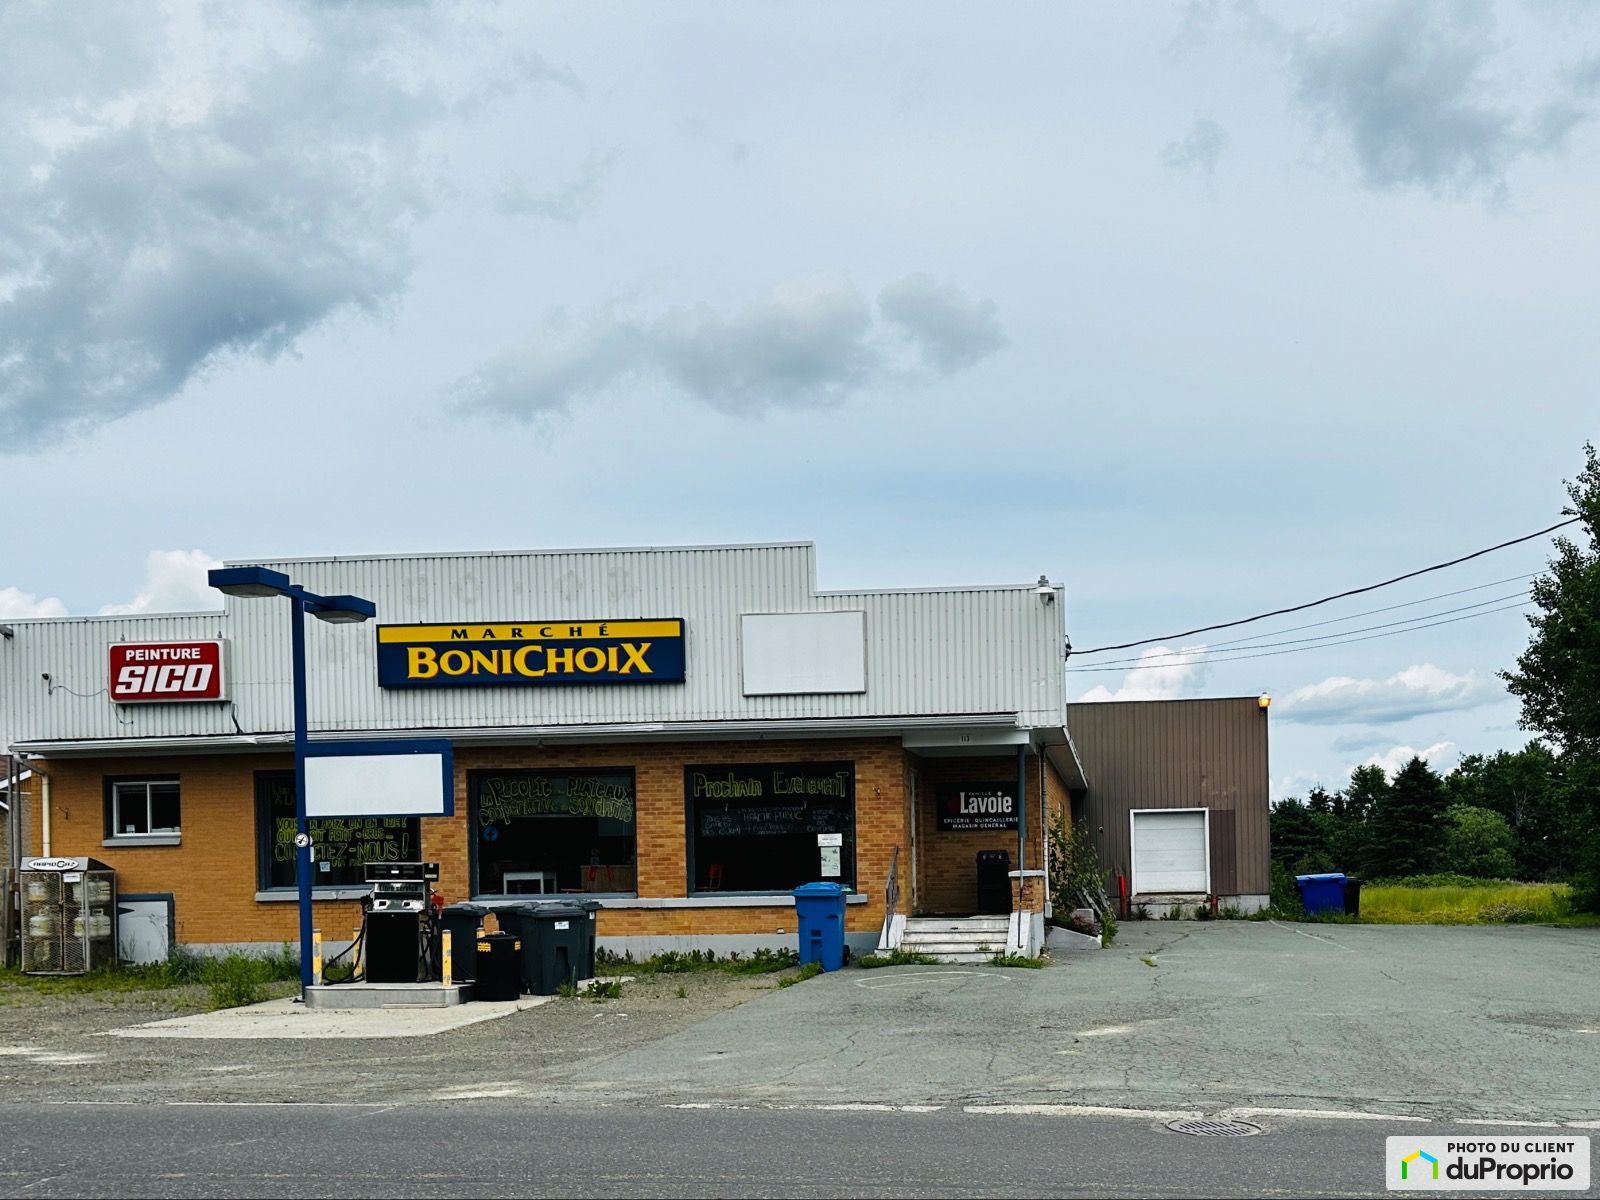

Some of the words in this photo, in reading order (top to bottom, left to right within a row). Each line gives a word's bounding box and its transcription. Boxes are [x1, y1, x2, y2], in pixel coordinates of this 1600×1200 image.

[450, 623, 610, 640] MARCHÉ
[125, 647, 201, 661] PEINTURE
[114, 663, 214, 694] SICO
[959, 791, 1013, 814] Lavoie
